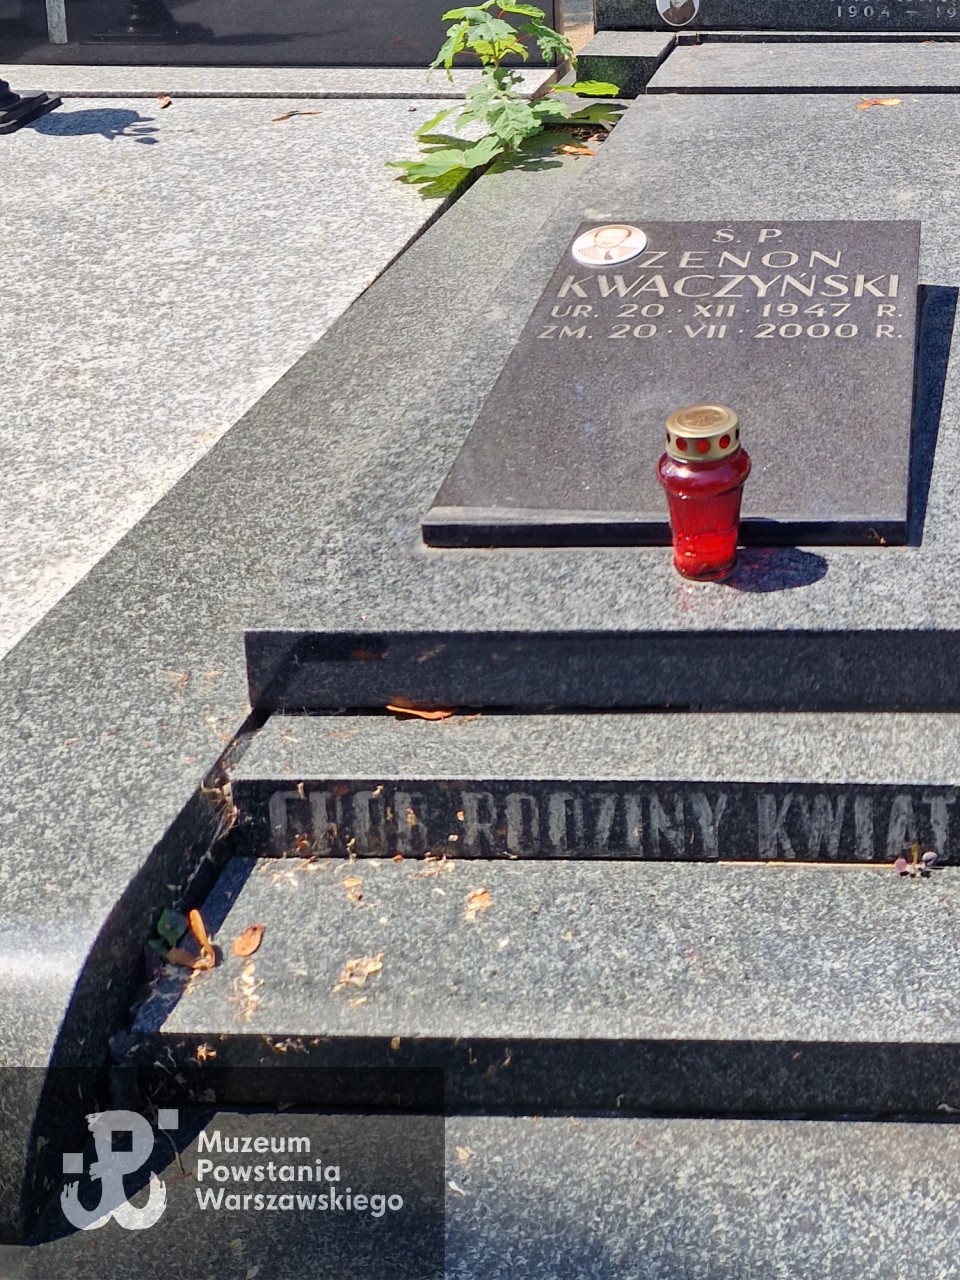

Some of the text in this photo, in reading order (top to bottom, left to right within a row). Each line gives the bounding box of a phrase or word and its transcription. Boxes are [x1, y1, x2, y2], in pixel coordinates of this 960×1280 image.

[757, 228, 783, 244] P.
[638, 250, 843, 269] ZENON
[556, 271, 900, 299] KWACZYŃSKI
[550, 303, 903, 318] UR. 20 XII 1947 R.
[537, 323, 903, 340] ZM. 20 VII 2000 R.
[460, 791, 728, 861] RODZINY
